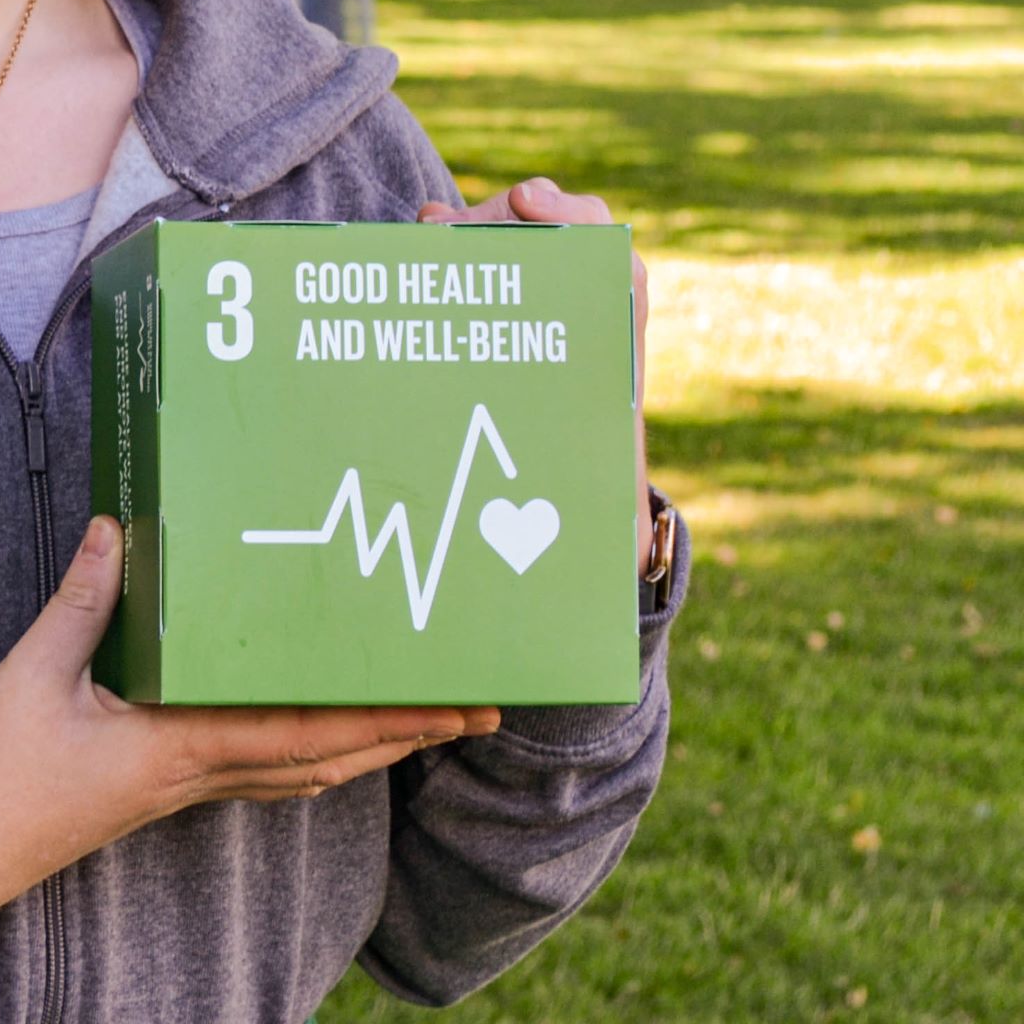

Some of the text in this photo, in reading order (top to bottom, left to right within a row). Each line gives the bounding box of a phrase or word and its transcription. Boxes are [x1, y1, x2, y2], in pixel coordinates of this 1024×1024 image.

[294, 261, 522, 305] GOOD HEALTH
[205, 260, 255, 362] 3
[295, 318, 567, 363] AND WELL-BEING
